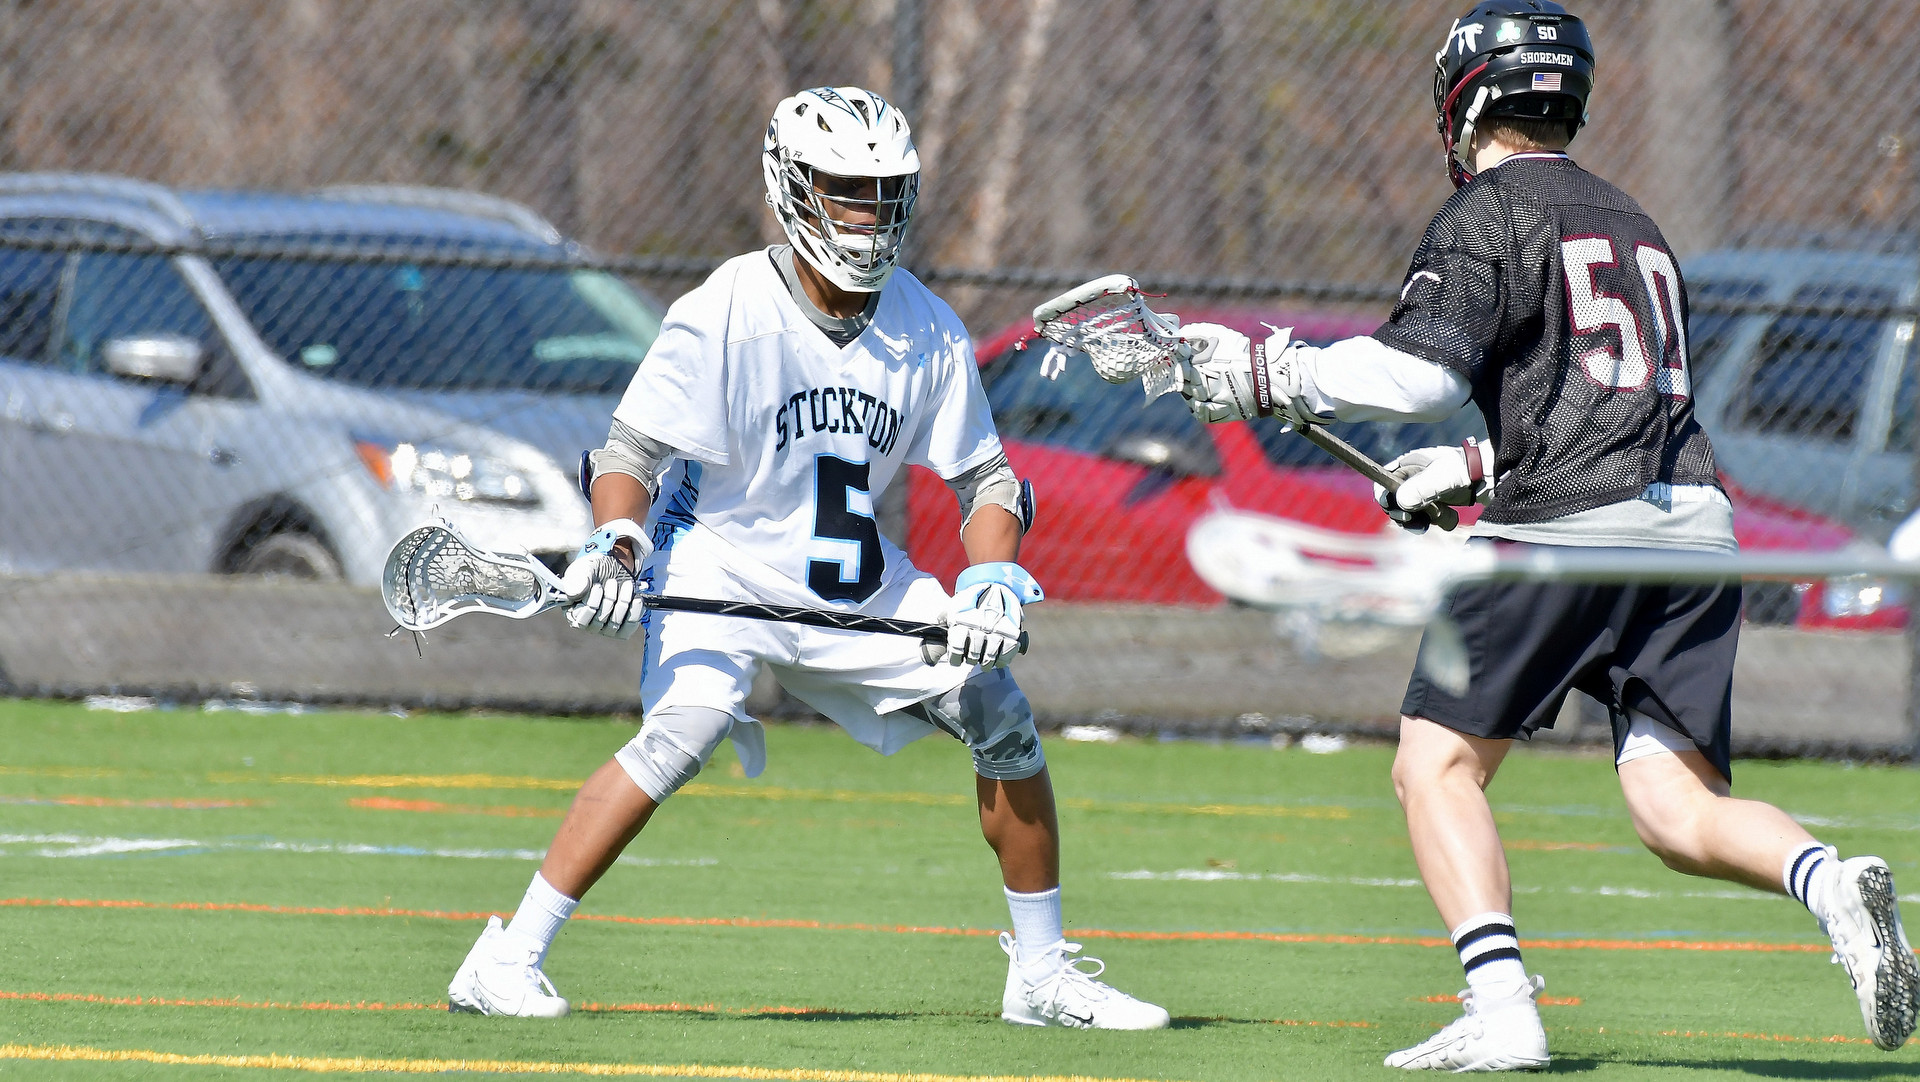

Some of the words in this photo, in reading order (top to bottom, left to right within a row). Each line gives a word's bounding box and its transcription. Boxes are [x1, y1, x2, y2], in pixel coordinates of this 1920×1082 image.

[1520, 52, 1574, 66] SHOREMEN
[1537, 26, 1558, 41] 50
[1560, 232, 1691, 401] 50
[1255, 343, 1270, 409] SHOREMEN
[775, 386, 905, 458] STOCKTON
[805, 452, 887, 606] 5
